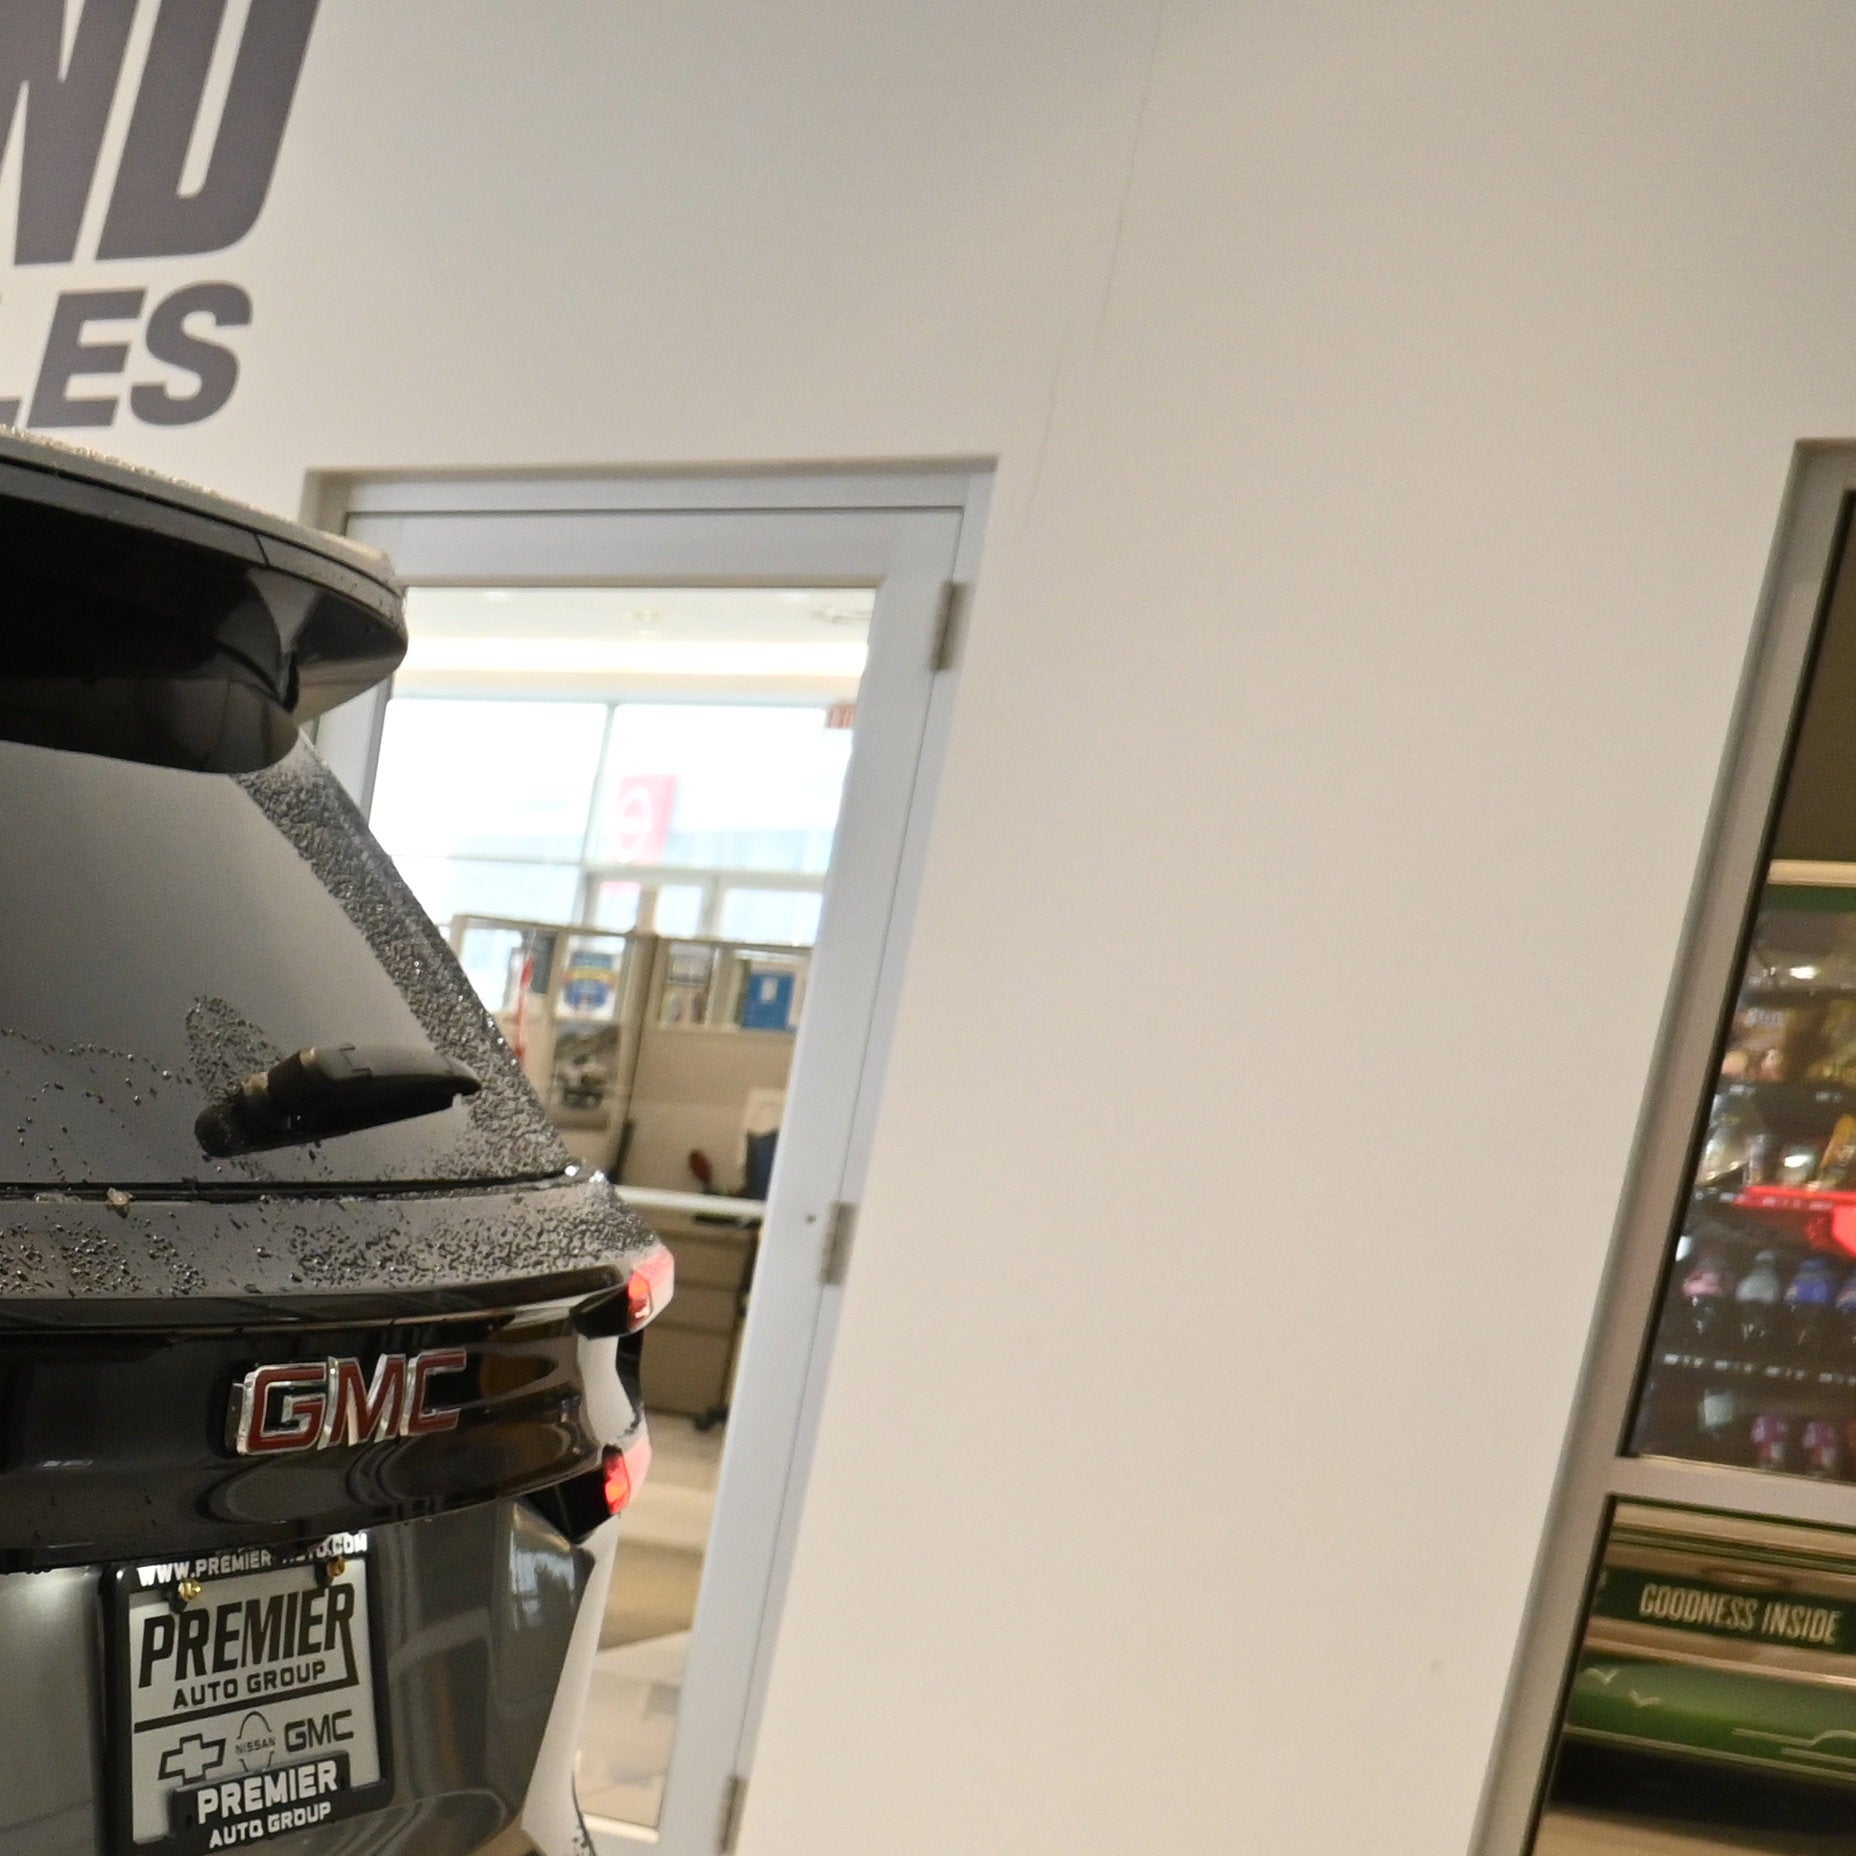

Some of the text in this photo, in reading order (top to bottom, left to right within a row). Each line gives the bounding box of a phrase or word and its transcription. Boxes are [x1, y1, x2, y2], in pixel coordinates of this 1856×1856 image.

[237, 1347, 467, 1456] GMC
[139, 1582, 356, 1688] PREMIER
[1640, 1583, 1842, 1645] GOODNESS INSIDE
[173, 1660, 326, 1710] AUTO GROUP
[236, 1737, 276, 1754] NISSAN
[284, 1709, 354, 1752] GMC
[197, 1760, 338, 1825] PREMIER
[209, 1801, 331, 1849] AUTO GROUP
